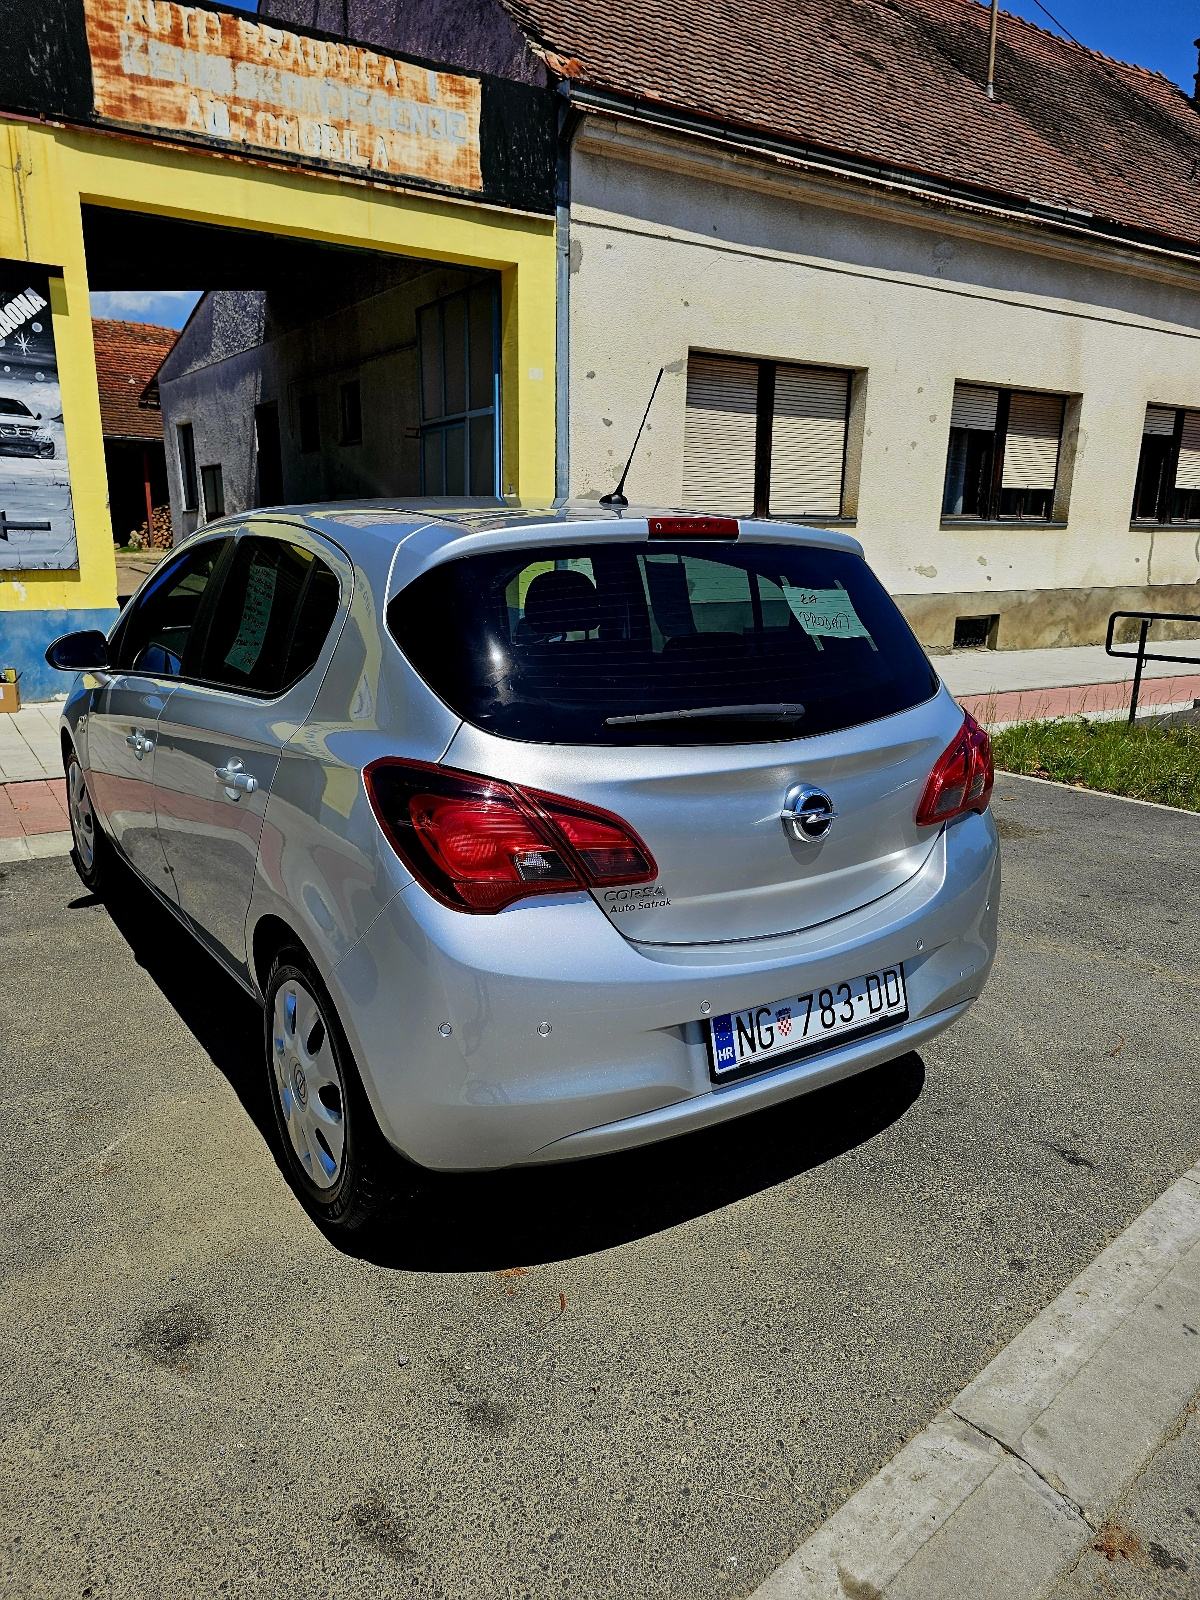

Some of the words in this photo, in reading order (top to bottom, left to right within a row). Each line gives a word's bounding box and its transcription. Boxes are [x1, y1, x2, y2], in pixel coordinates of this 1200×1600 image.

[124, 0, 222, 45] AUTO
[238, 15, 399, 89] PRAONICA
[187, 94, 390, 172] AUTOMOBILA
[603, 885, 666, 903] CORSA
[610, 903, 636, 914] Auto
[735, 1007, 775, 1059] NG
[798, 969, 901, 1037] 783-DD
[716, 1046, 734, 1063] HR
